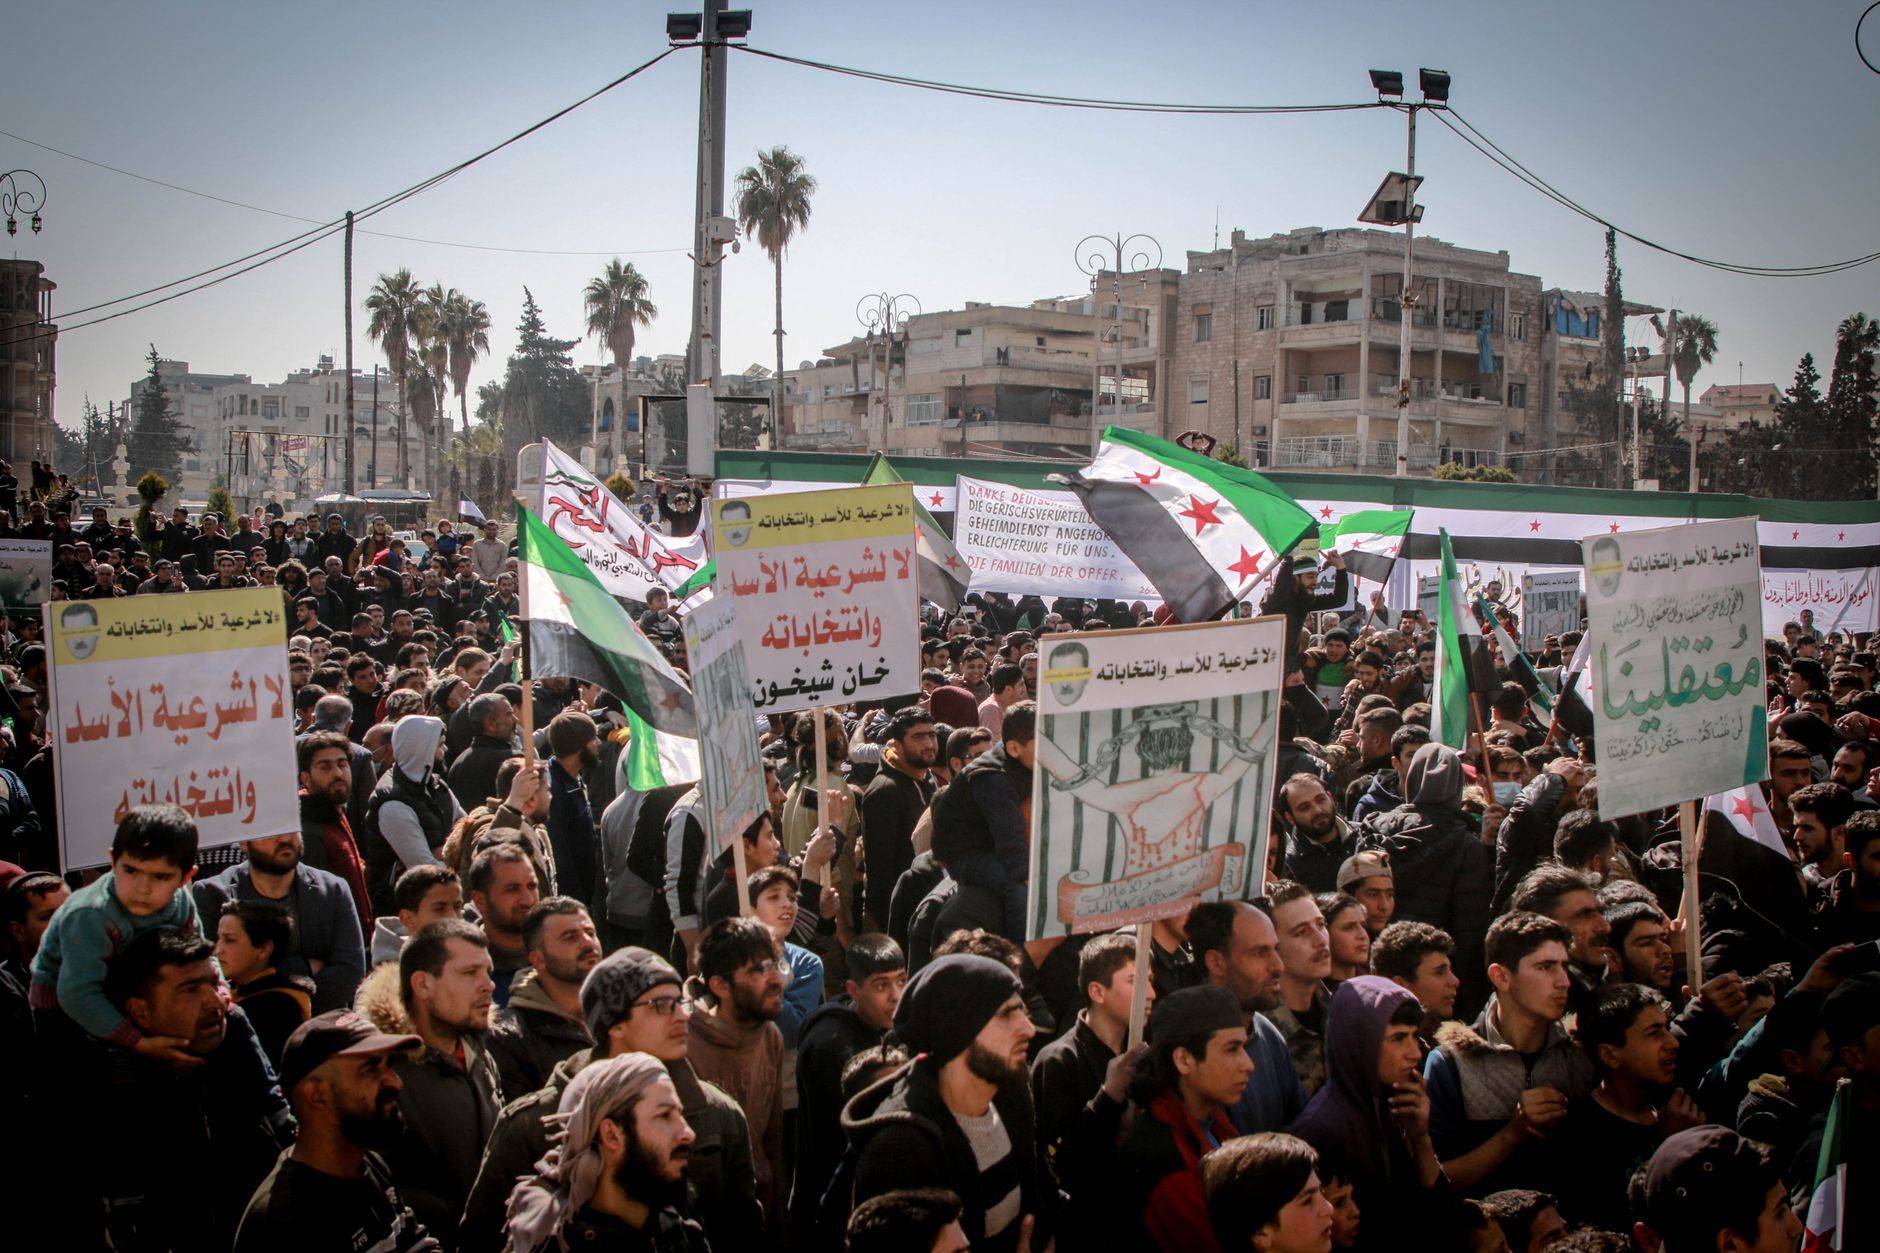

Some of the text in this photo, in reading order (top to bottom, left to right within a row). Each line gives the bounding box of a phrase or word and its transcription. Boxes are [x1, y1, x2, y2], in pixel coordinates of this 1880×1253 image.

[968, 485, 1006, 501] DANKE
[968, 499, 983, 513] DIE
[968, 516, 1050, 538] GEHEIMDIENST
[967, 532, 1049, 554] ERLEICHTERUNG
[1056, 541, 1079, 556] FÜR
[892, 546, 911, 580] لا
[967, 555, 987, 570] DIE
[990, 559, 1046, 577] FAMILIEN
[1050, 565, 1073, 578] DER
[761, 605, 882, 657] وانتخاباته
[264, 672, 285, 719] لا
[752, 656, 890, 708] خان شيخون
[65, 675, 144, 744] الأسد
